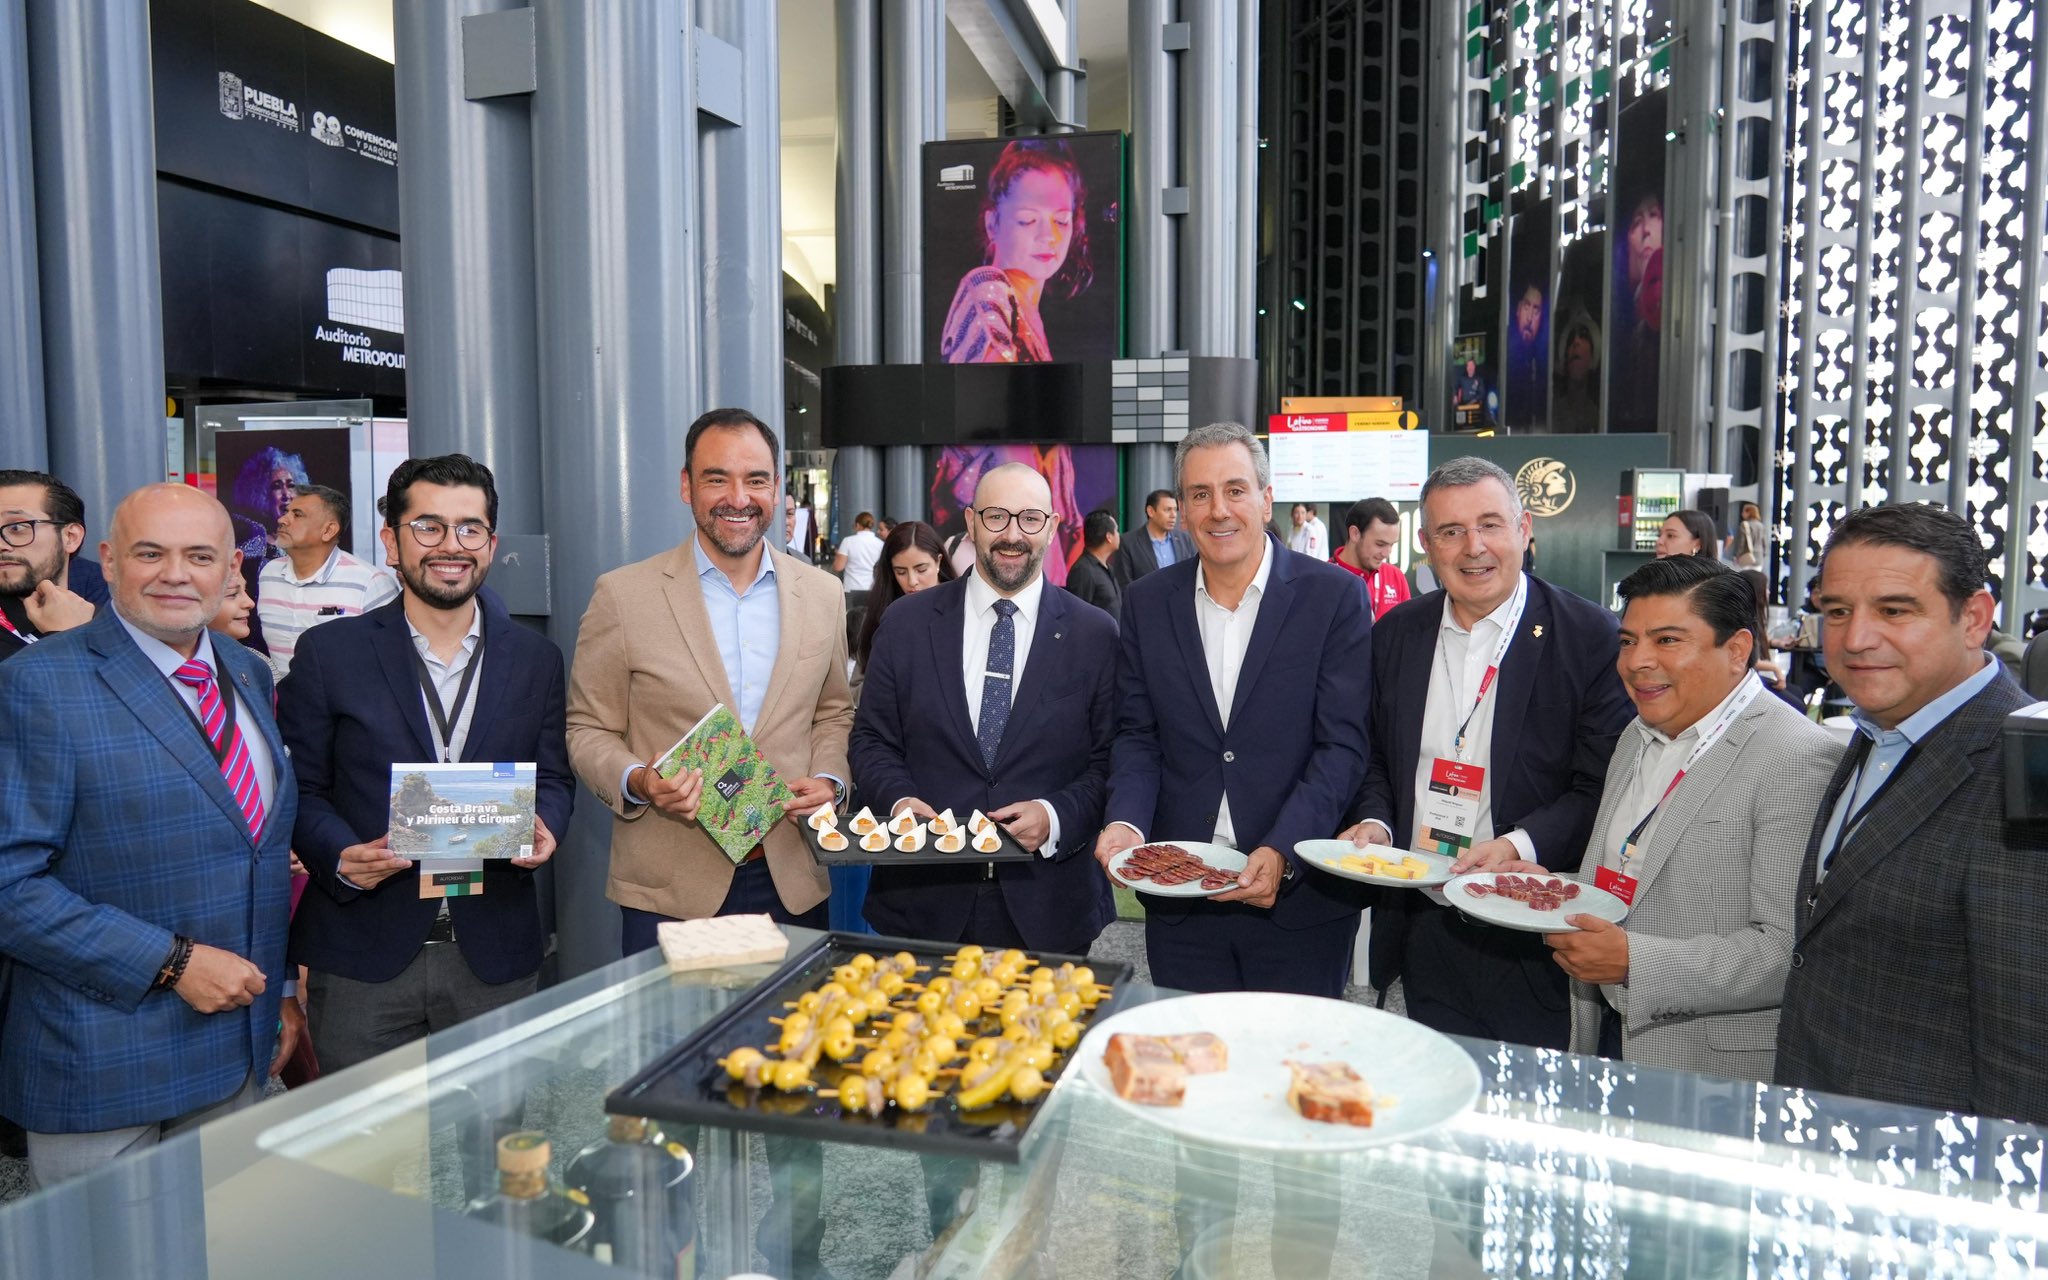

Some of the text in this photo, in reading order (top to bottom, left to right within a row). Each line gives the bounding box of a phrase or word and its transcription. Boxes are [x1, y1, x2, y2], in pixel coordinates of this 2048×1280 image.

[244, 86, 298, 119] PUEBLA
[356, 140, 398, 161] Y PARQUES
[315, 325, 371, 347] Auditorio
[429, 804, 498, 814] Costa Brava
[406, 817, 413, 827] y
[416, 814, 459, 825] Pirineu
[461, 814, 475, 824] de
